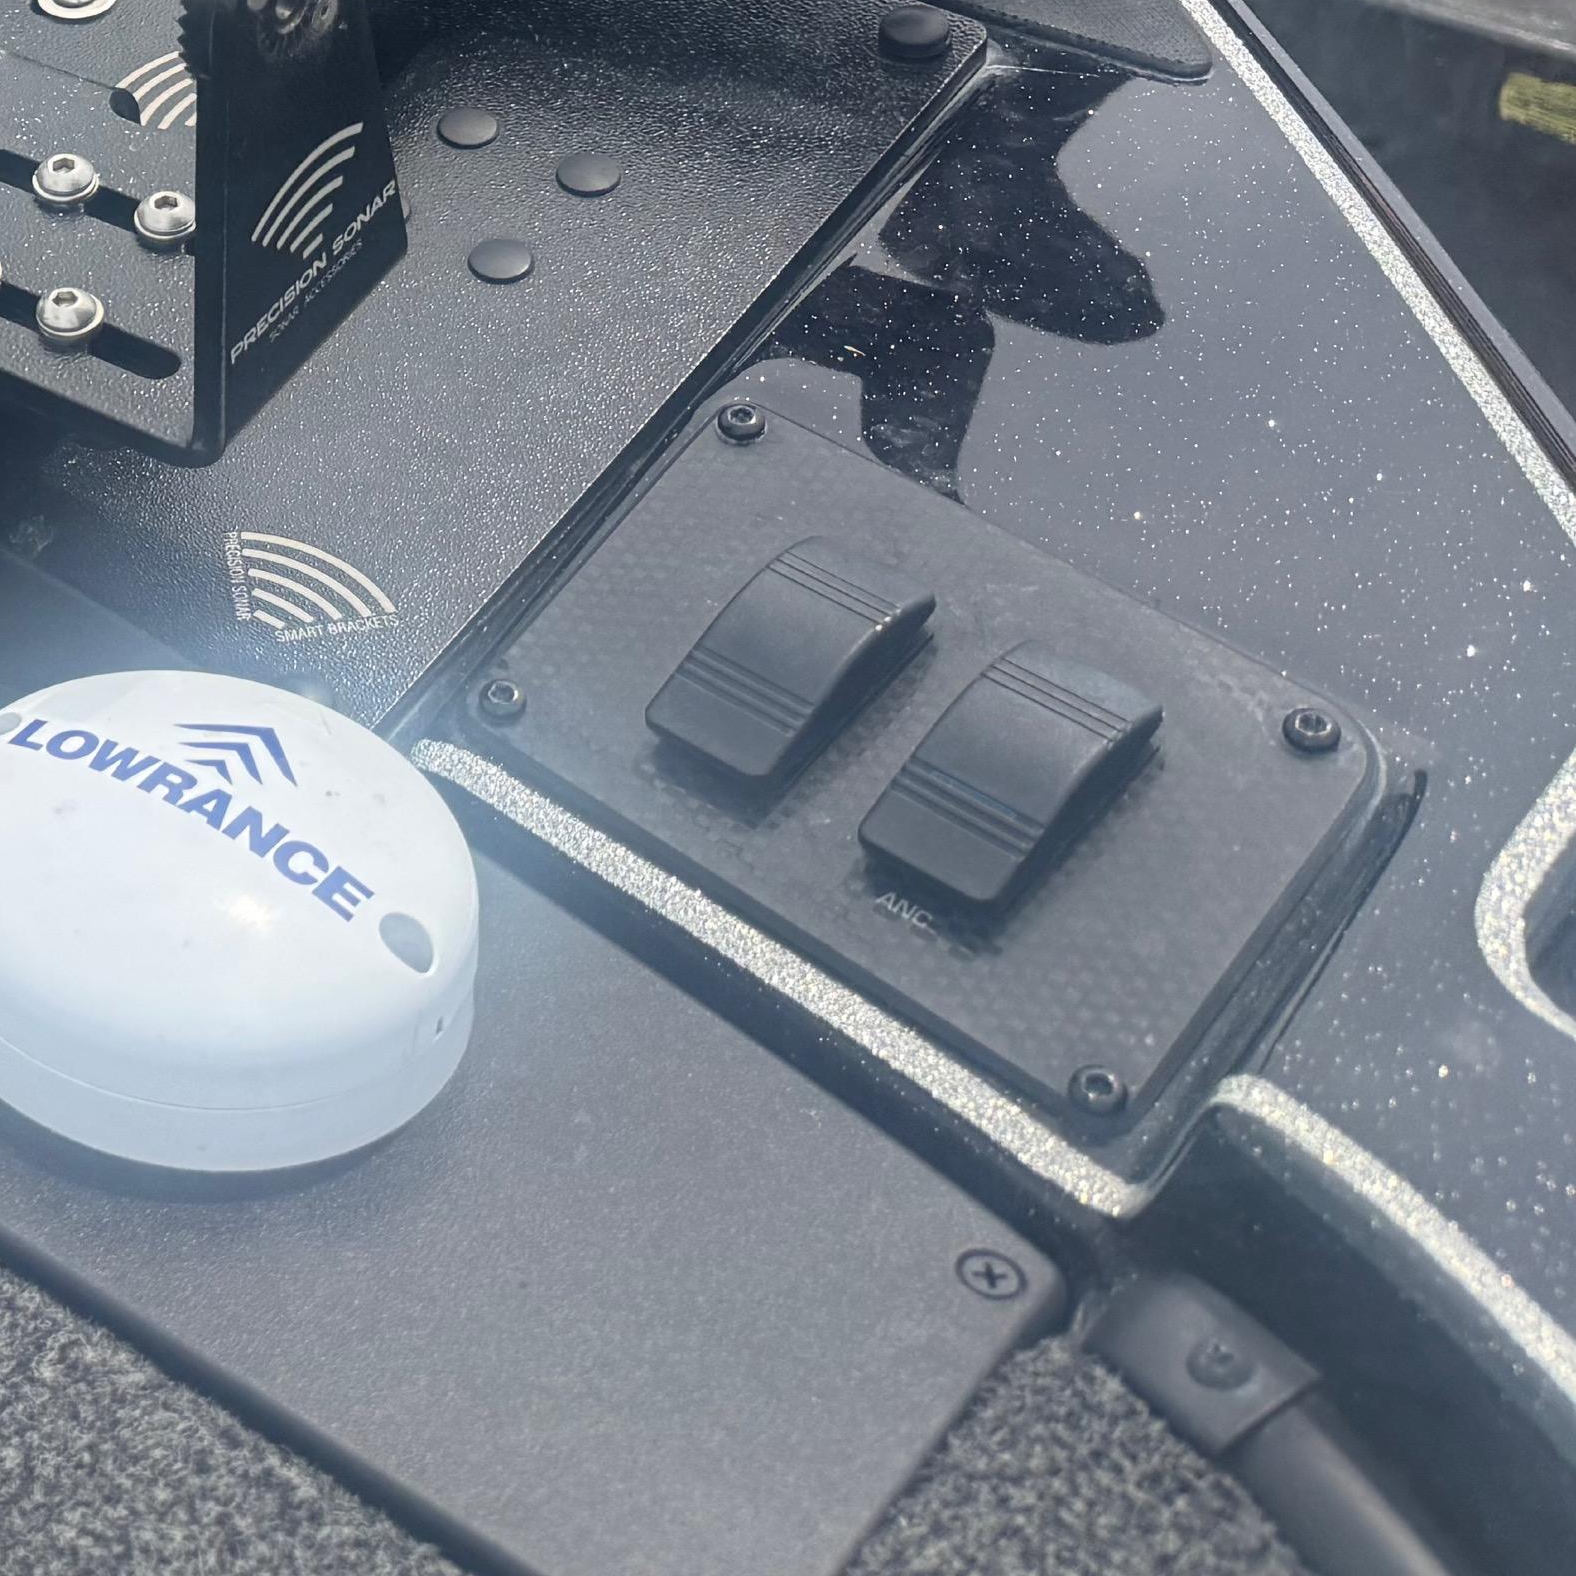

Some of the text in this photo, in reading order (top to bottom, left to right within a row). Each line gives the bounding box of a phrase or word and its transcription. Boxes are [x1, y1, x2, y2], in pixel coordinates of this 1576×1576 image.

[230, 179, 396, 365] PRECISION SONAR
[222, 530, 252, 622] PRECISION SONAR
[274, 613, 400, 643] SMART BRACKETS
[7, 718, 375, 923] LOWRANCE
